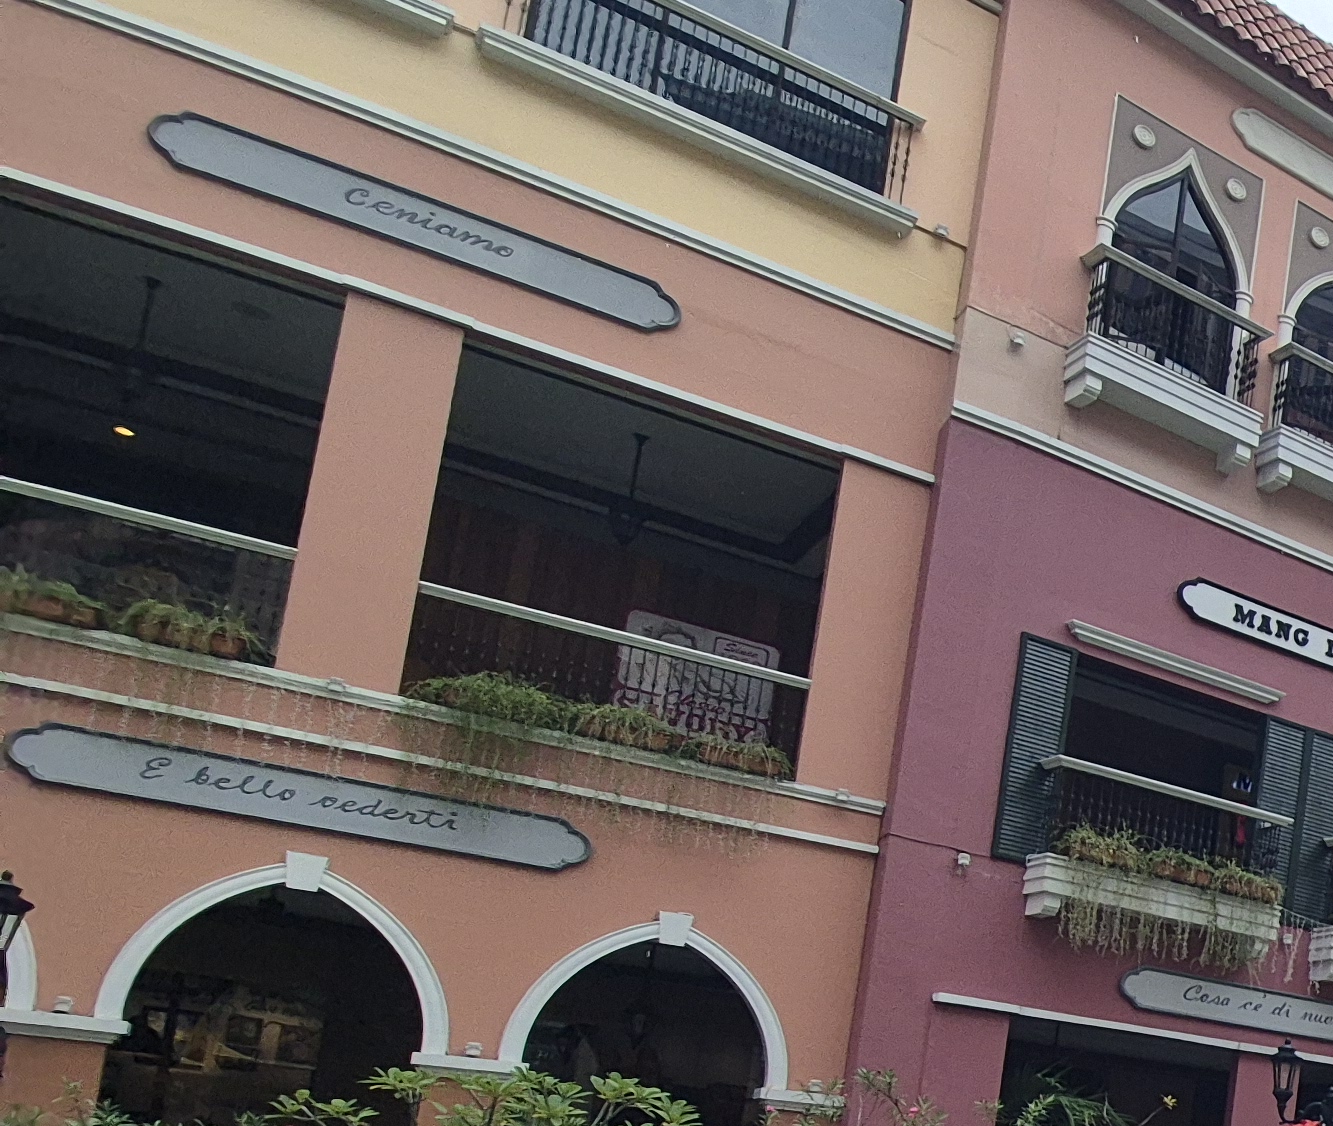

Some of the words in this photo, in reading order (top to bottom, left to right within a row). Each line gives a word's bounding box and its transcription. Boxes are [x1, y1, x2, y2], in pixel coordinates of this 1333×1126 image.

[1232, 603, 1310, 647] MANG
[186, 766, 296, 802] bello
[1182, 984, 1230, 1008] Cosa
[1271, 1001, 1292, 1019] di
